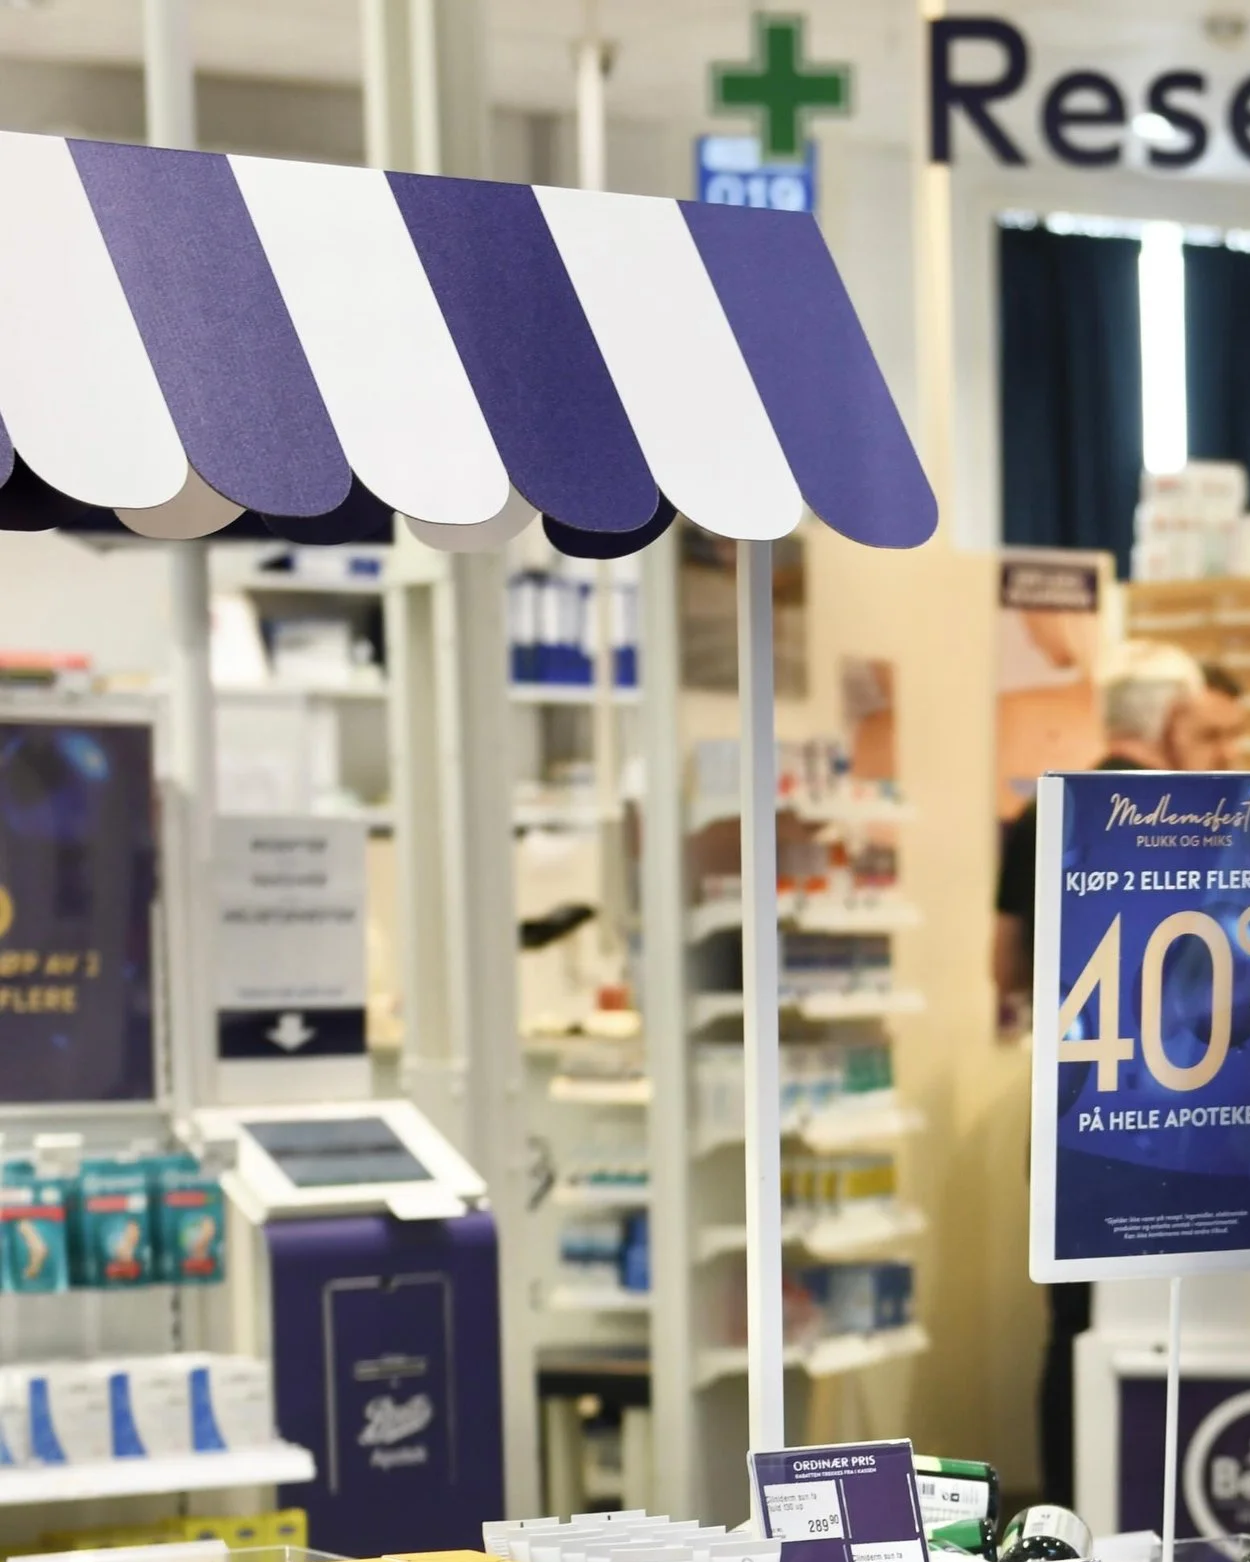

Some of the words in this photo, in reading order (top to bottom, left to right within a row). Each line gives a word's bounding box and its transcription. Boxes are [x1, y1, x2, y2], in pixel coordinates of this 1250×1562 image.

[1137, 836, 1177, 847] PLUKK
[1180, 835, 1200, 847] OG
[1203, 835, 1233, 847] MIKS
[1066, 872, 1119, 896] KJØP
[1123, 871, 1135, 891] 2
[1141, 870, 1200, 890] ELLER
[1079, 1107, 1104, 1132] PÅ
[1109, 1110, 1160, 1131] HELE
[793, 1457, 849, 1472] ORDINÆR
[851, 1454, 876, 1467] PRIS
[808, 1519, 829, 1533] 289
[829, 1514, 839, 1524] 90
